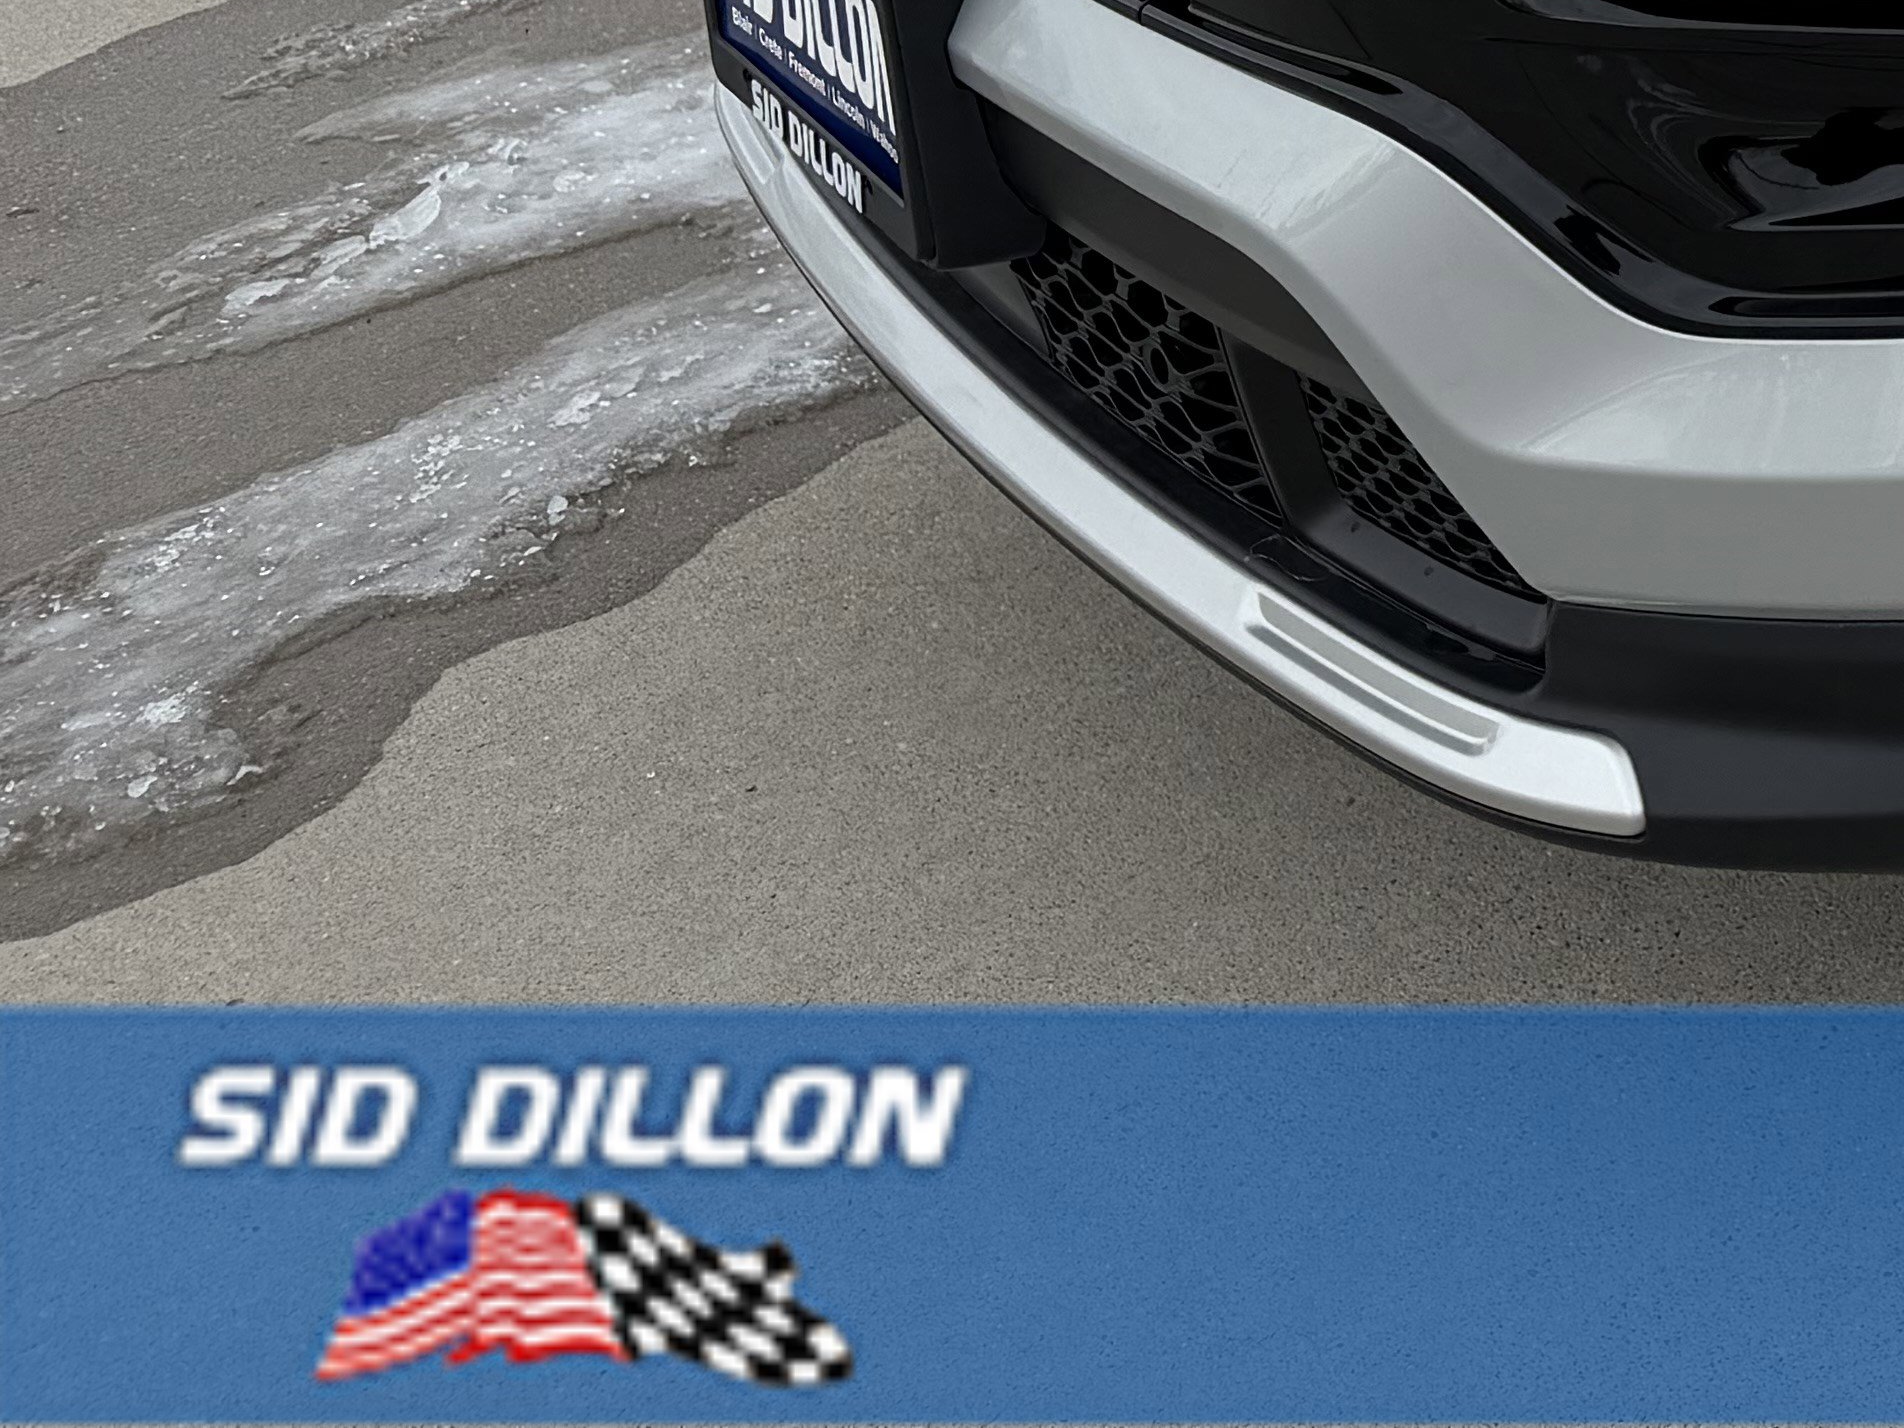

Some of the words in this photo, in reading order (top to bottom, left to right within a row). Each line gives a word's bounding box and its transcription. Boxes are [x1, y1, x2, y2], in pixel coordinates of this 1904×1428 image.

[732, 6, 753, 35] Blair
[758, 28, 783, 60] Crete
[788, 51, 826, 96] Fremont
[832, 86, 866, 130] Lincoln
[751, 79, 784, 141] SID
[788, 110, 863, 214] DILLON
